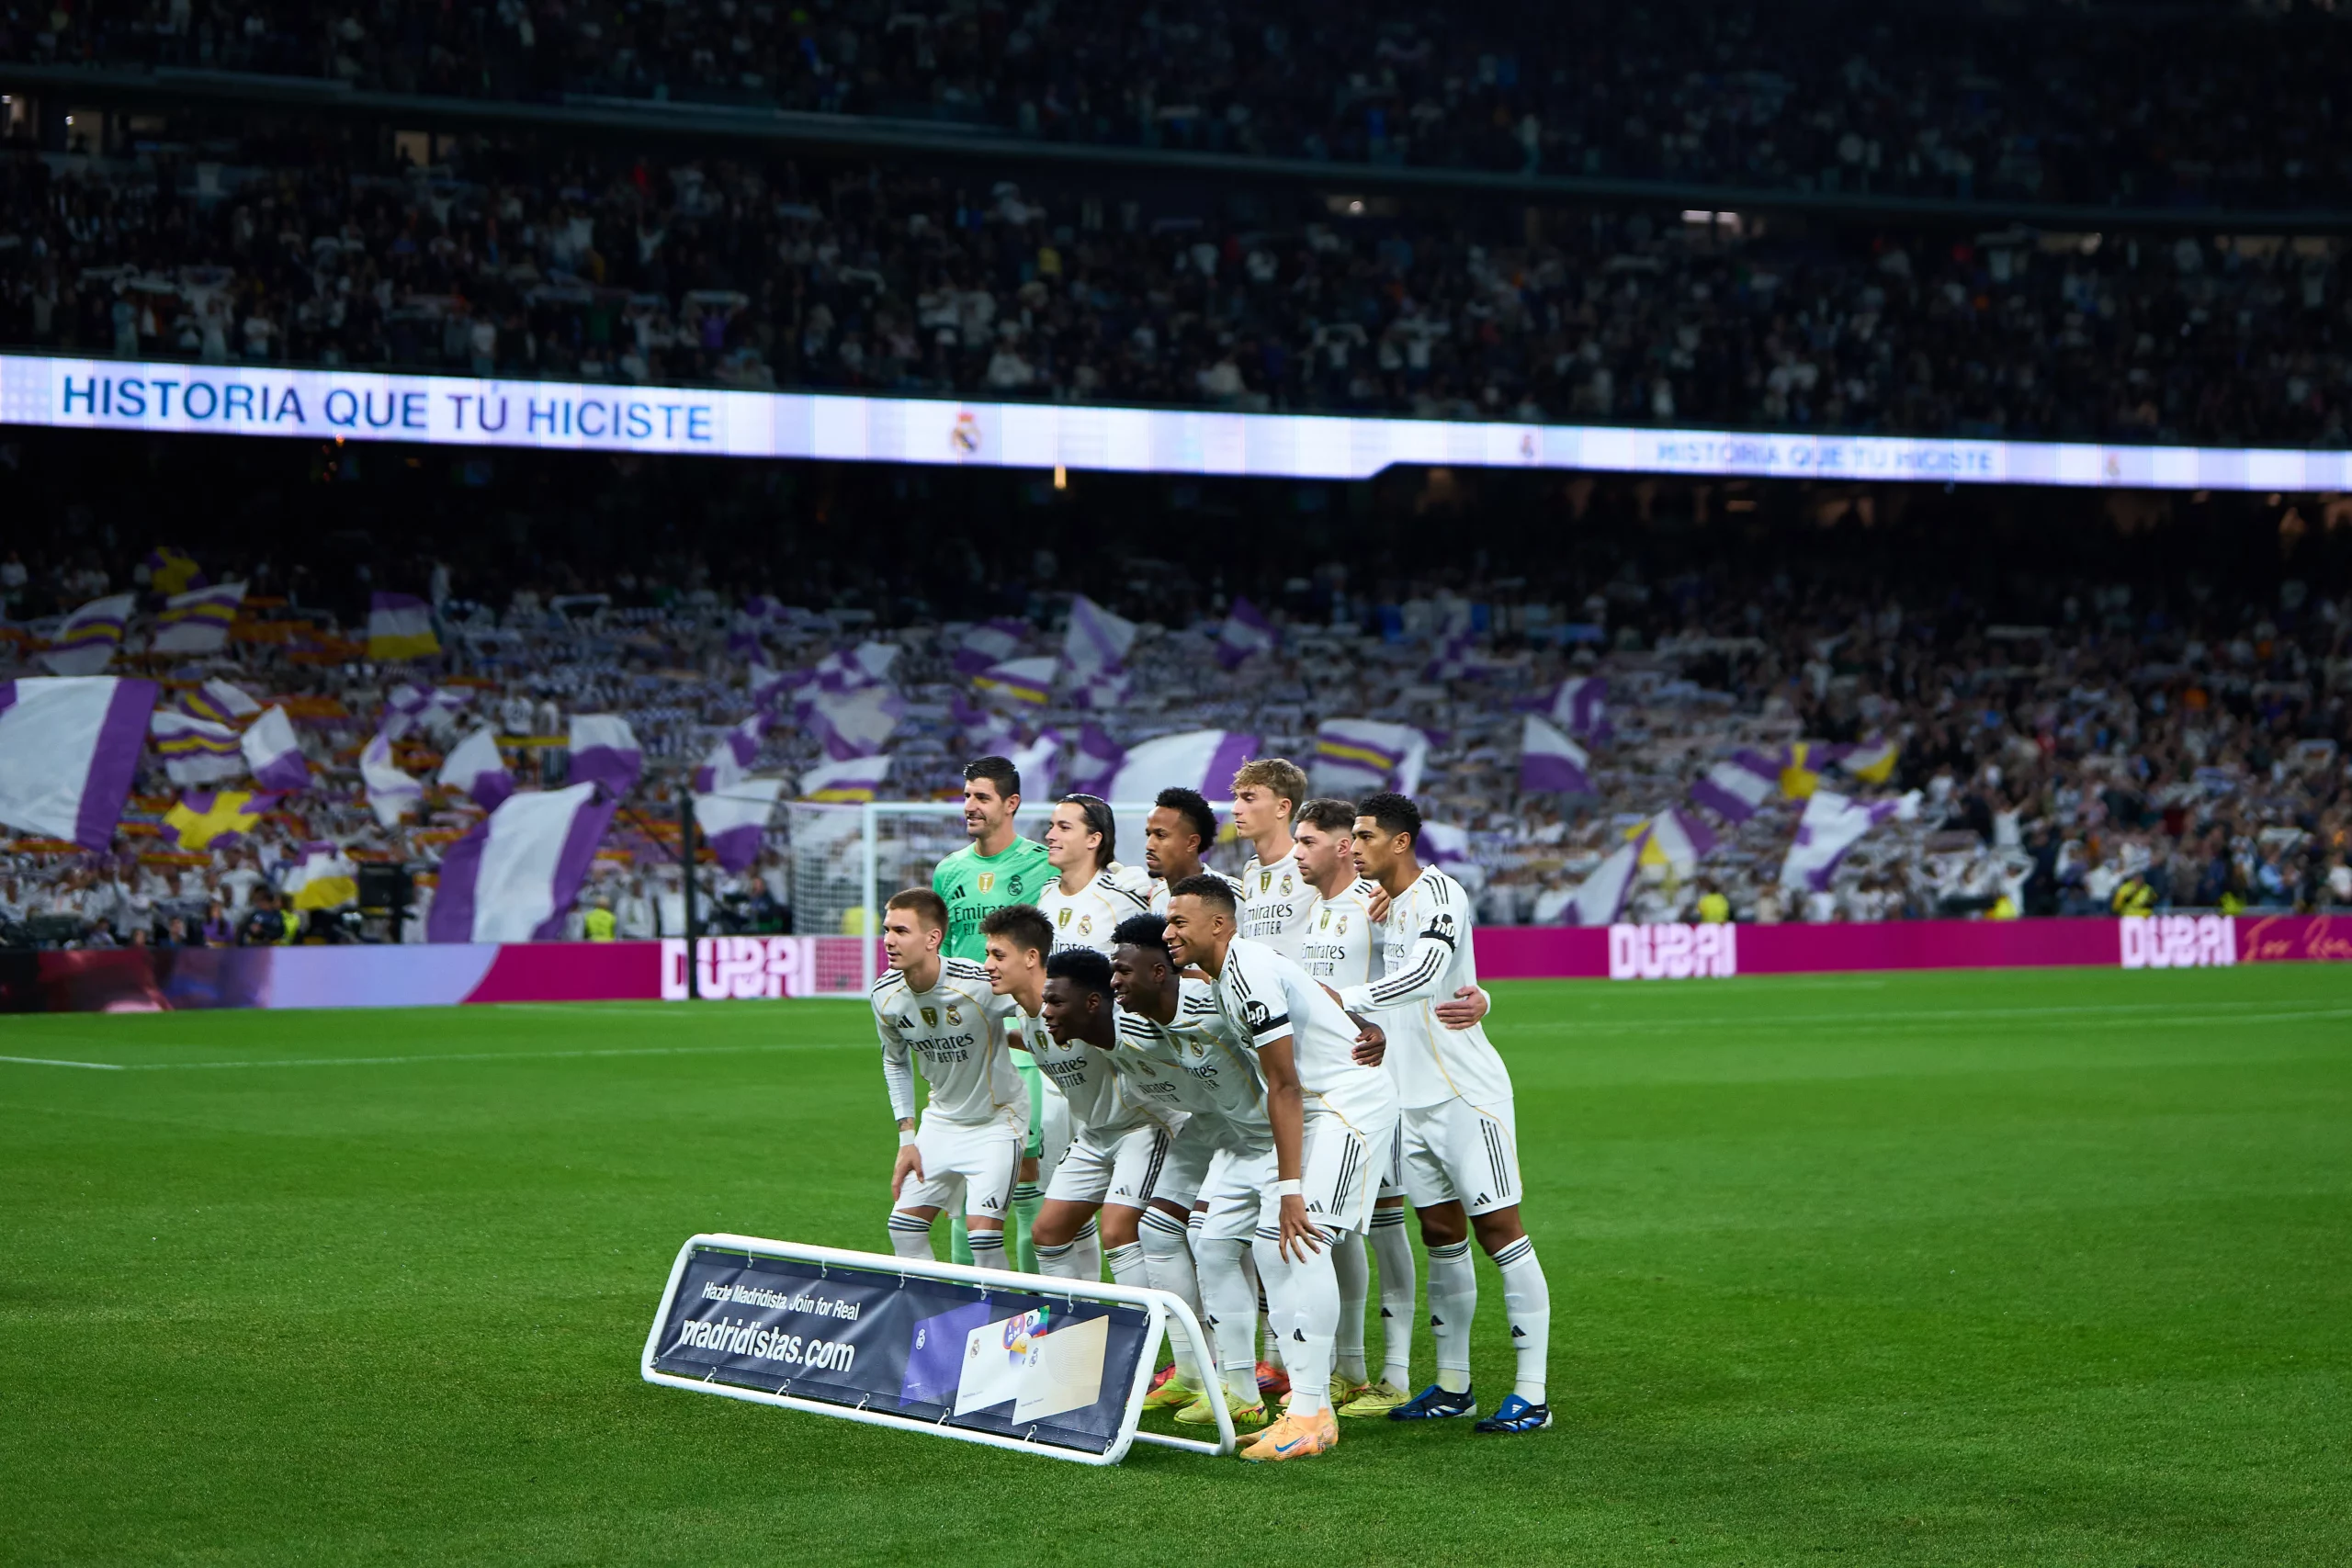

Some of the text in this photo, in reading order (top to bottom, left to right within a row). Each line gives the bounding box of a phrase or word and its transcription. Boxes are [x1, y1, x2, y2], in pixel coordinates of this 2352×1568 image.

[62, 375, 306, 423] HISTORIA
[324, 388, 429, 429] QUE
[526, 396, 714, 442] HICISTE
[662, 937, 817, 1000] DUBAI
[1609, 921, 1737, 980] DUBAI
[2120, 915, 2236, 969] DUBAI
[905, 1032, 974, 1052] Emirates
[937, 1049, 968, 1063] BETTER
[701, 1281, 731, 1302] Hazte
[789, 1293, 814, 1314] Join
[816, 1296, 833, 1316] for
[832, 1300, 861, 1321] Real
[678, 1316, 856, 1372] madridistas.com
